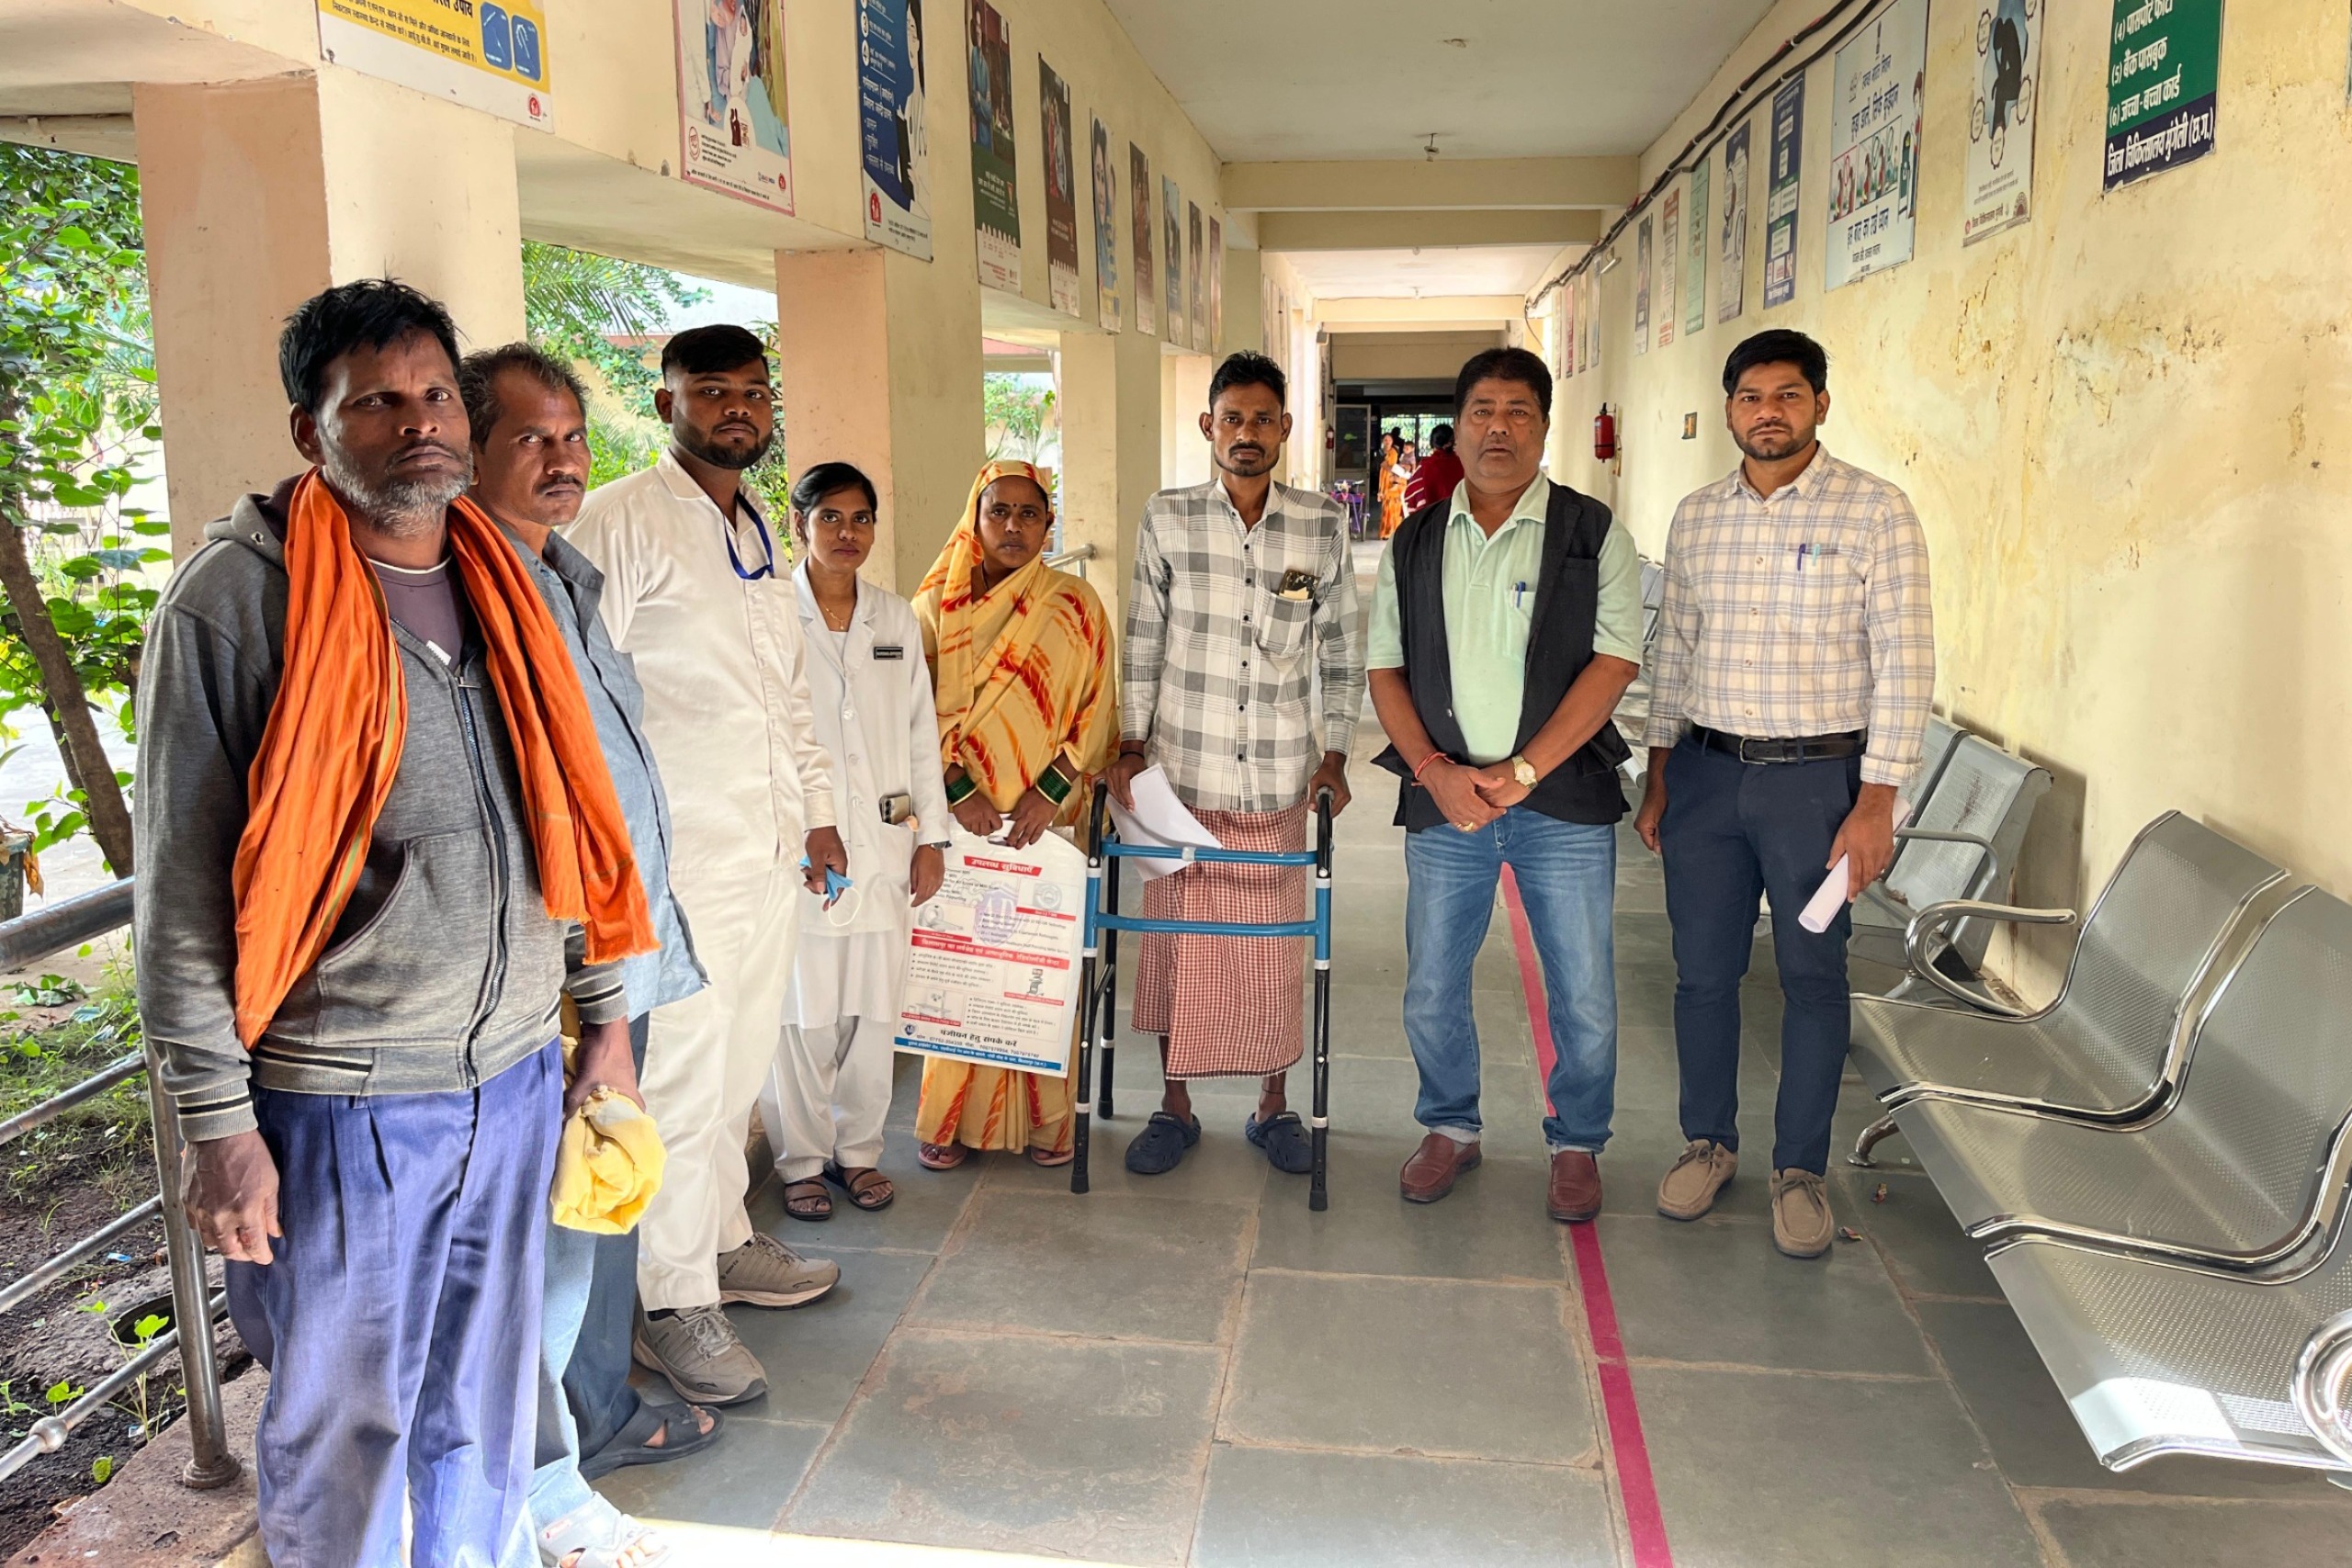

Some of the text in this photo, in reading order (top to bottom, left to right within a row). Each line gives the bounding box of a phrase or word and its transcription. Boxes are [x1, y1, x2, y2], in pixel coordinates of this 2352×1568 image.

[2115, 18, 2126, 44] (4)
[2111, 61, 2122, 86] (5)
[2139, 37, 2168, 72] पासबुक
[2109, 104, 2120, 129] (6)
[2163, 62, 2182, 101] कार्ड
[2108, 142, 2124, 176] जिला
[2125, 131, 2166, 170] चिकित्सालय
[2165, 111, 2188, 162] मुंगेली
